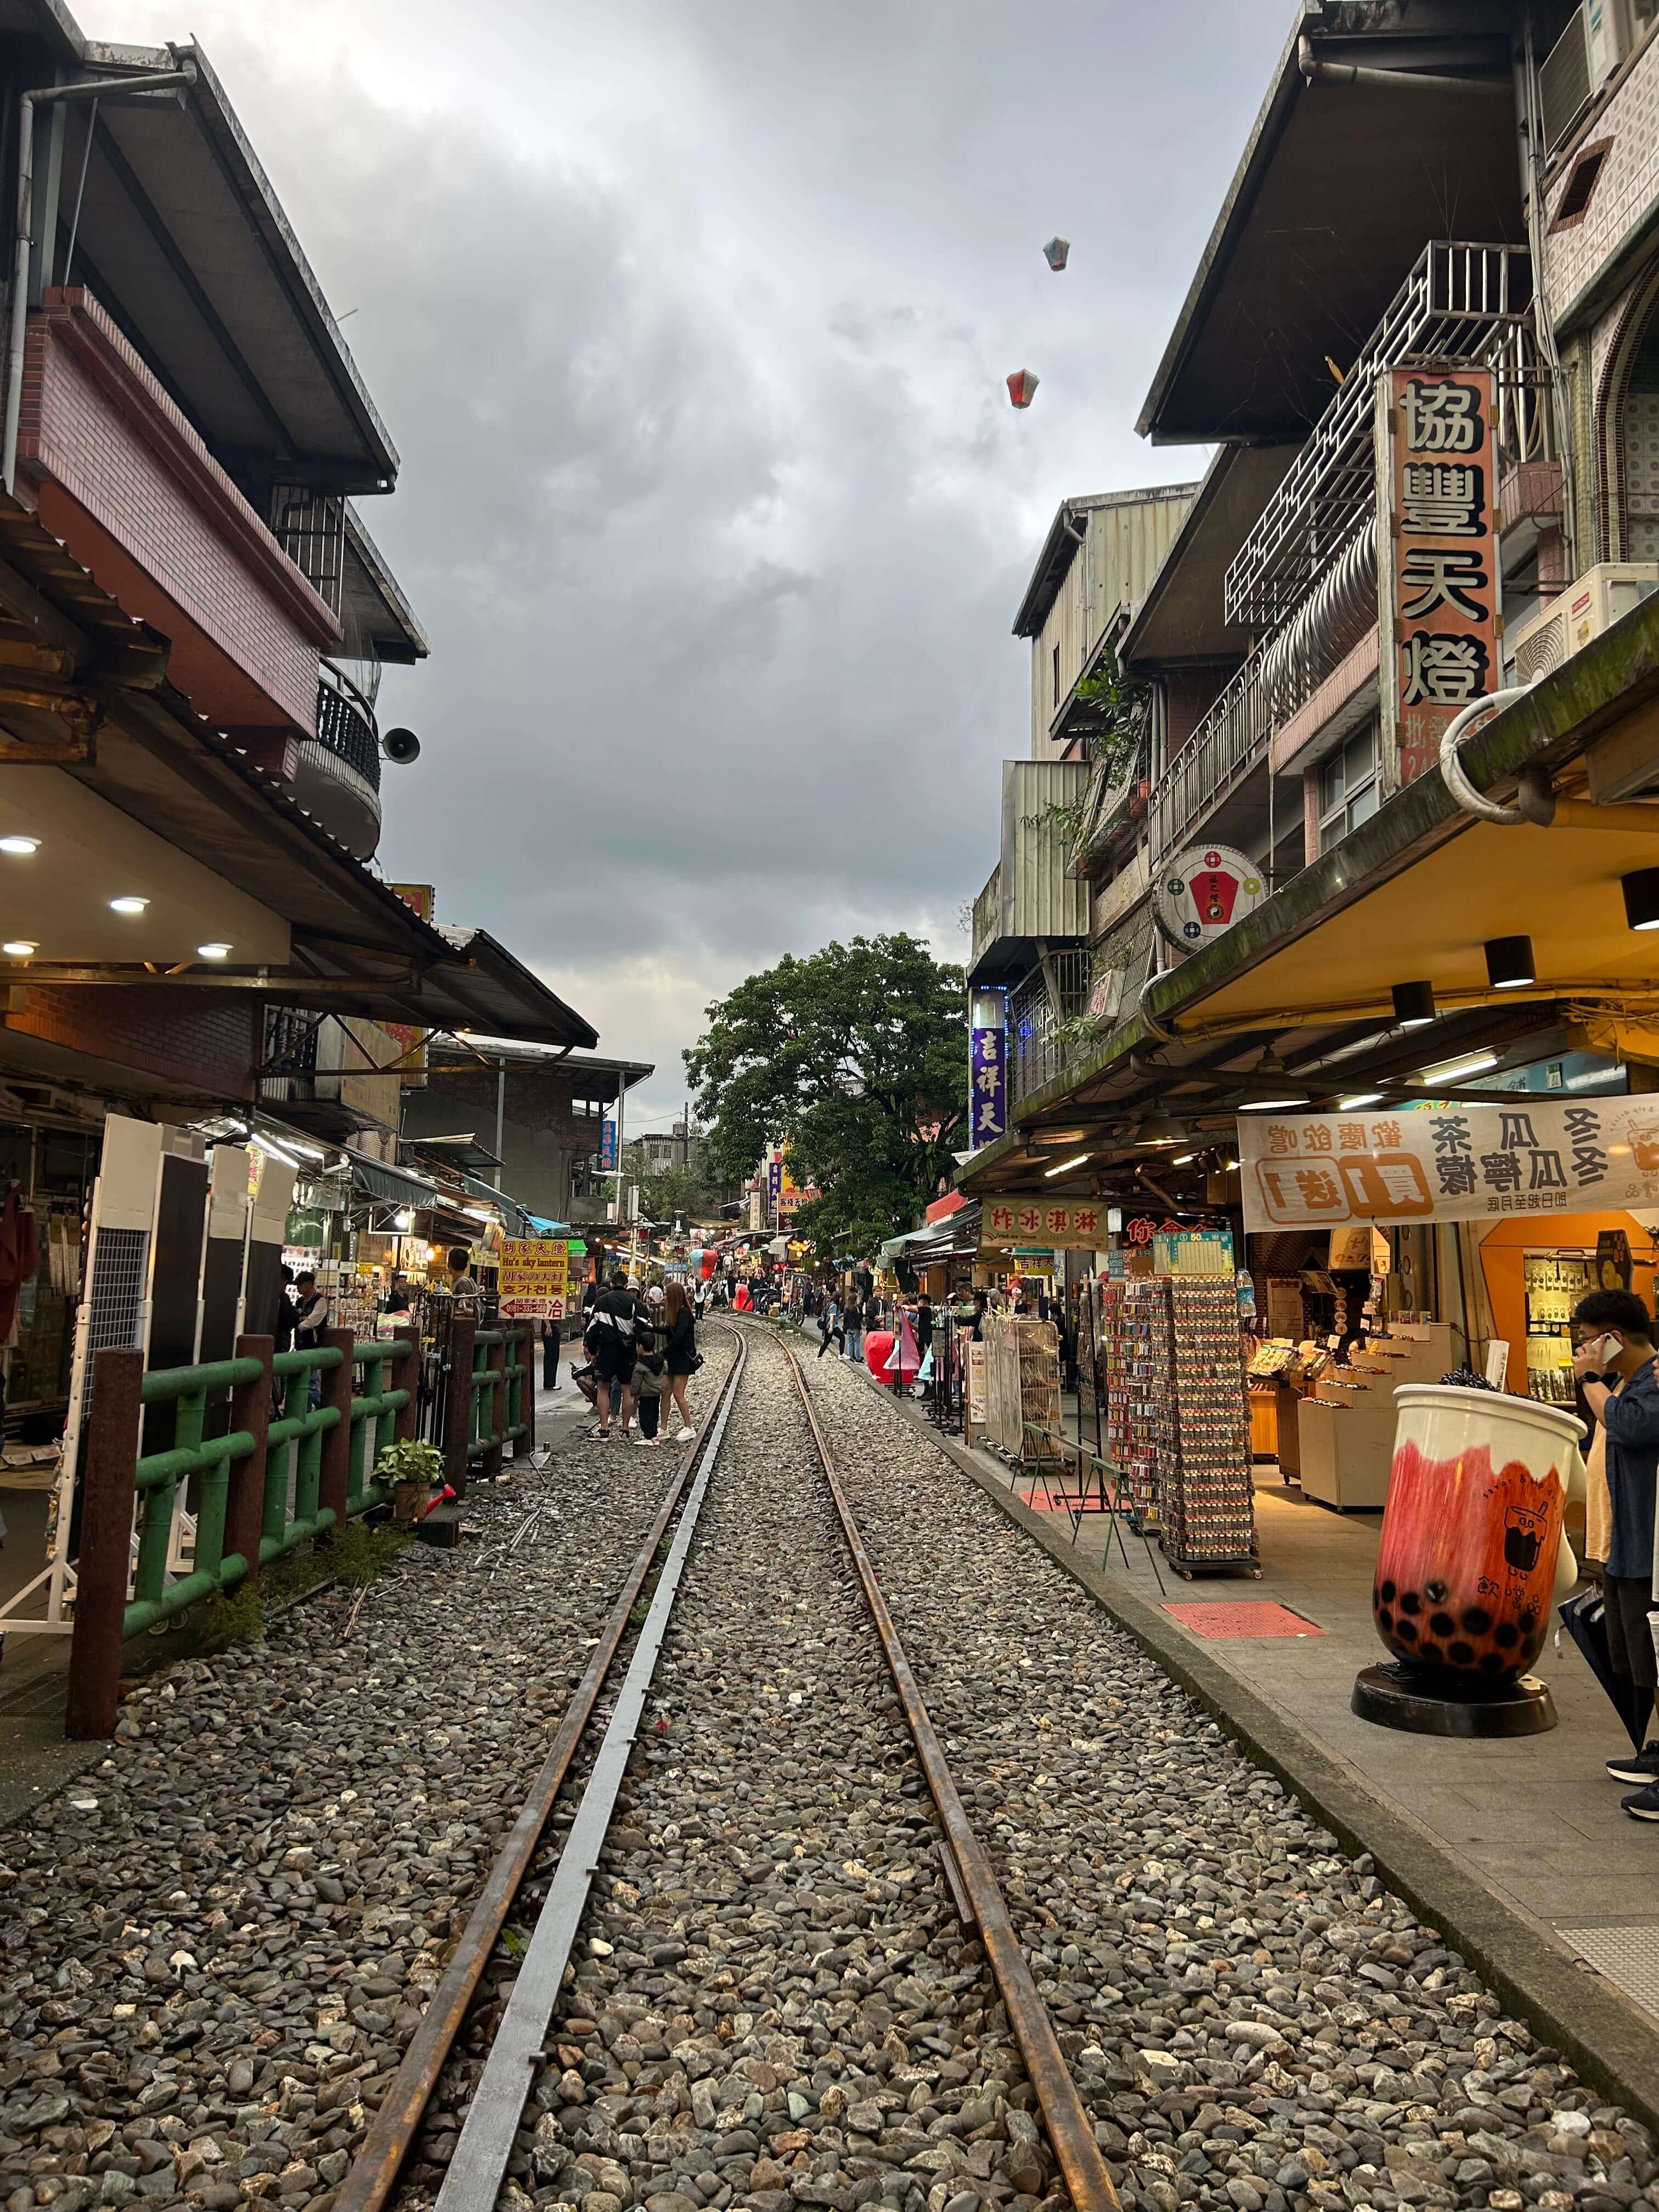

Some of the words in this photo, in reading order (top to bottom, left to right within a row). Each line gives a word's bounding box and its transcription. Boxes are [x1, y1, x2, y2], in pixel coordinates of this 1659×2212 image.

[1399, 379, 1488, 708] 協豐天燈
[977, 1030, 1004, 1149] 吉祥天
[992, 1207, 1097, 1232] 炸冰淇淋
[1190, 1233, 1202, 1241] 50
[502, 1240, 566, 1255] 胡家天燈
[503, 1257, 520, 1266] Hu's
[522, 1256, 536, 1268] sky
[537, 1257, 565, 1267] lantern
